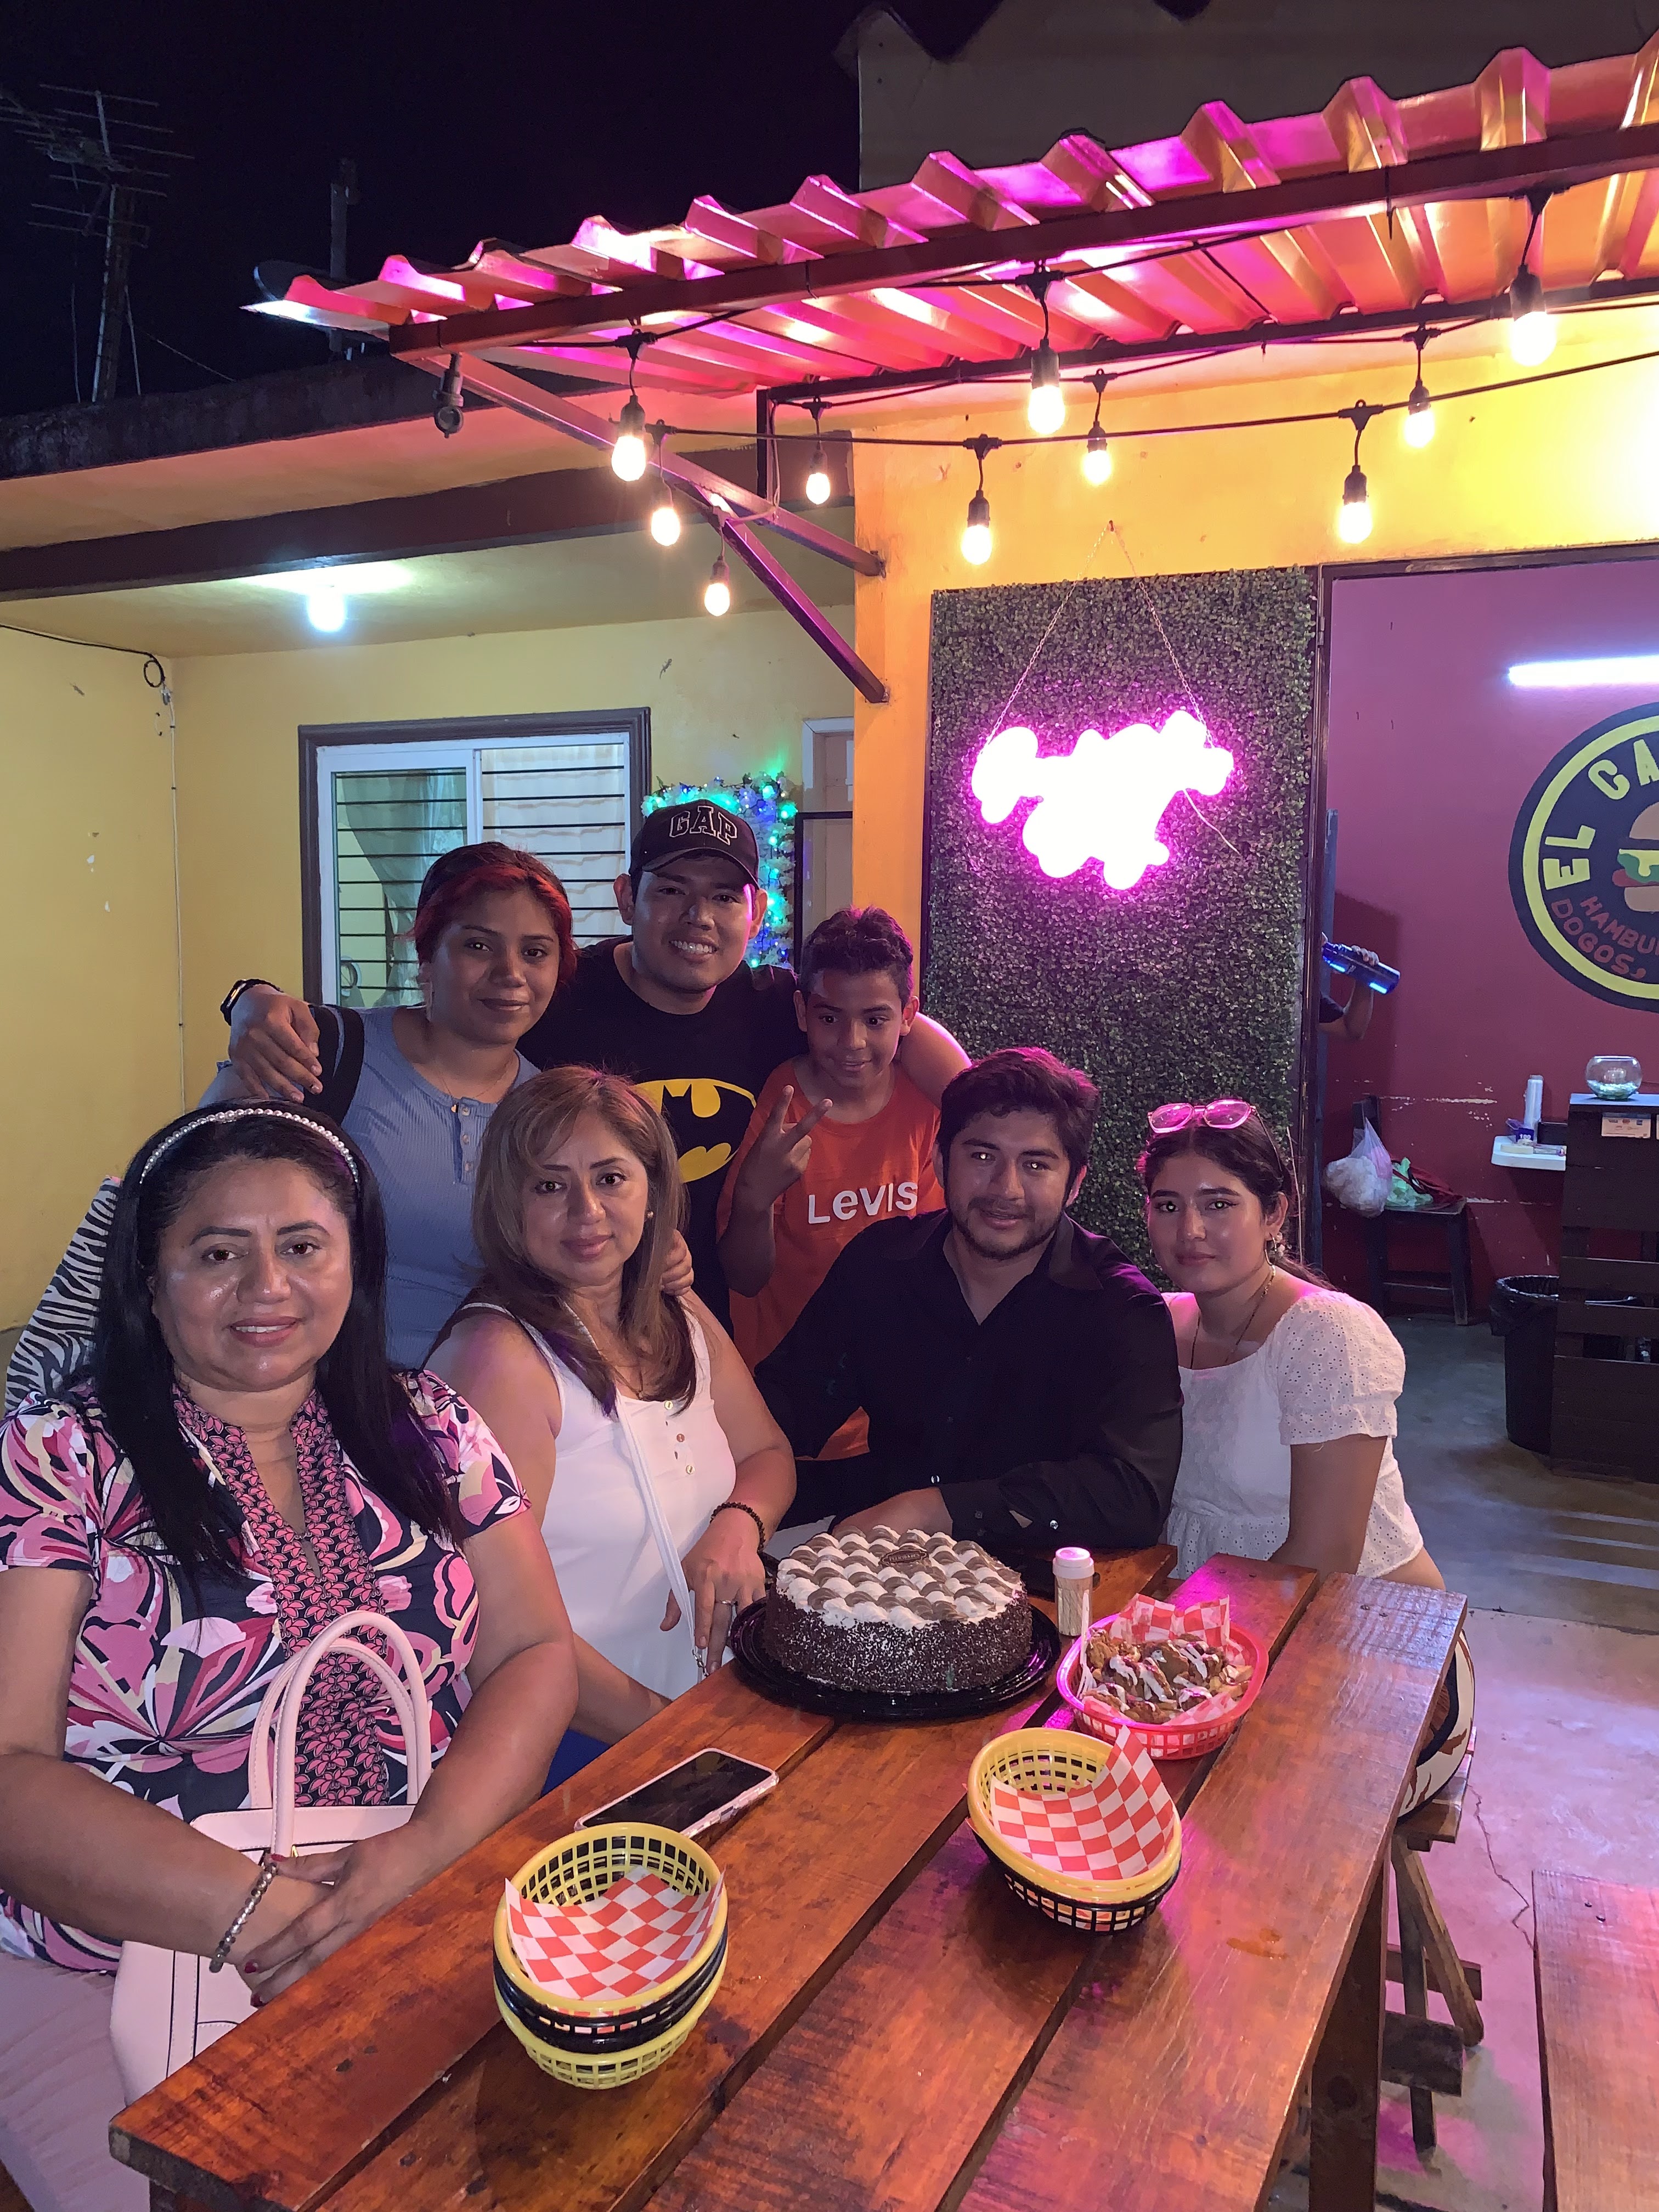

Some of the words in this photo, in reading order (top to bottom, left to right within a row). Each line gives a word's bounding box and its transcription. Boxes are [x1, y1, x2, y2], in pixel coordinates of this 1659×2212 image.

[669, 805, 737, 845] GAP
[1543, 825, 1595, 890] EL
[1580, 896, 1659, 955] HAMBU
